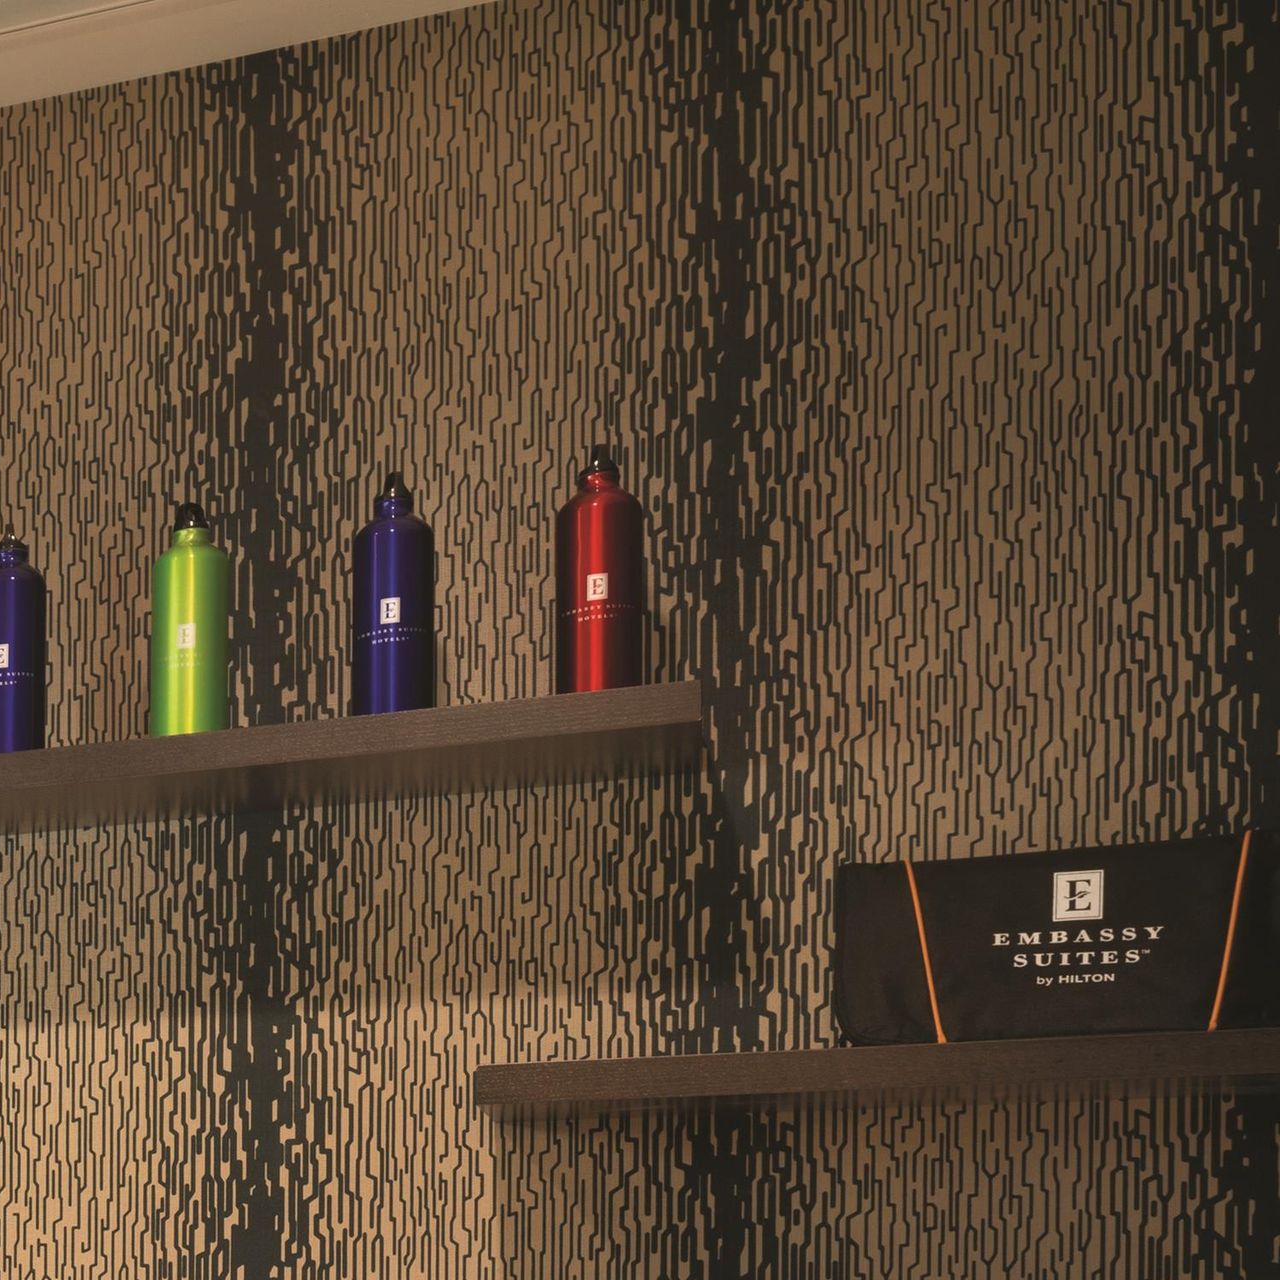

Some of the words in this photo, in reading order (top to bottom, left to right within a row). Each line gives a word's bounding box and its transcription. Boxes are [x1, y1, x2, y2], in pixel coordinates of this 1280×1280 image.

[1064, 878, 1093, 912] E
[992, 925, 1165, 947] EMBASSY
[1036, 975, 1054, 987] by
[1058, 972, 1116, 985] HILTON
